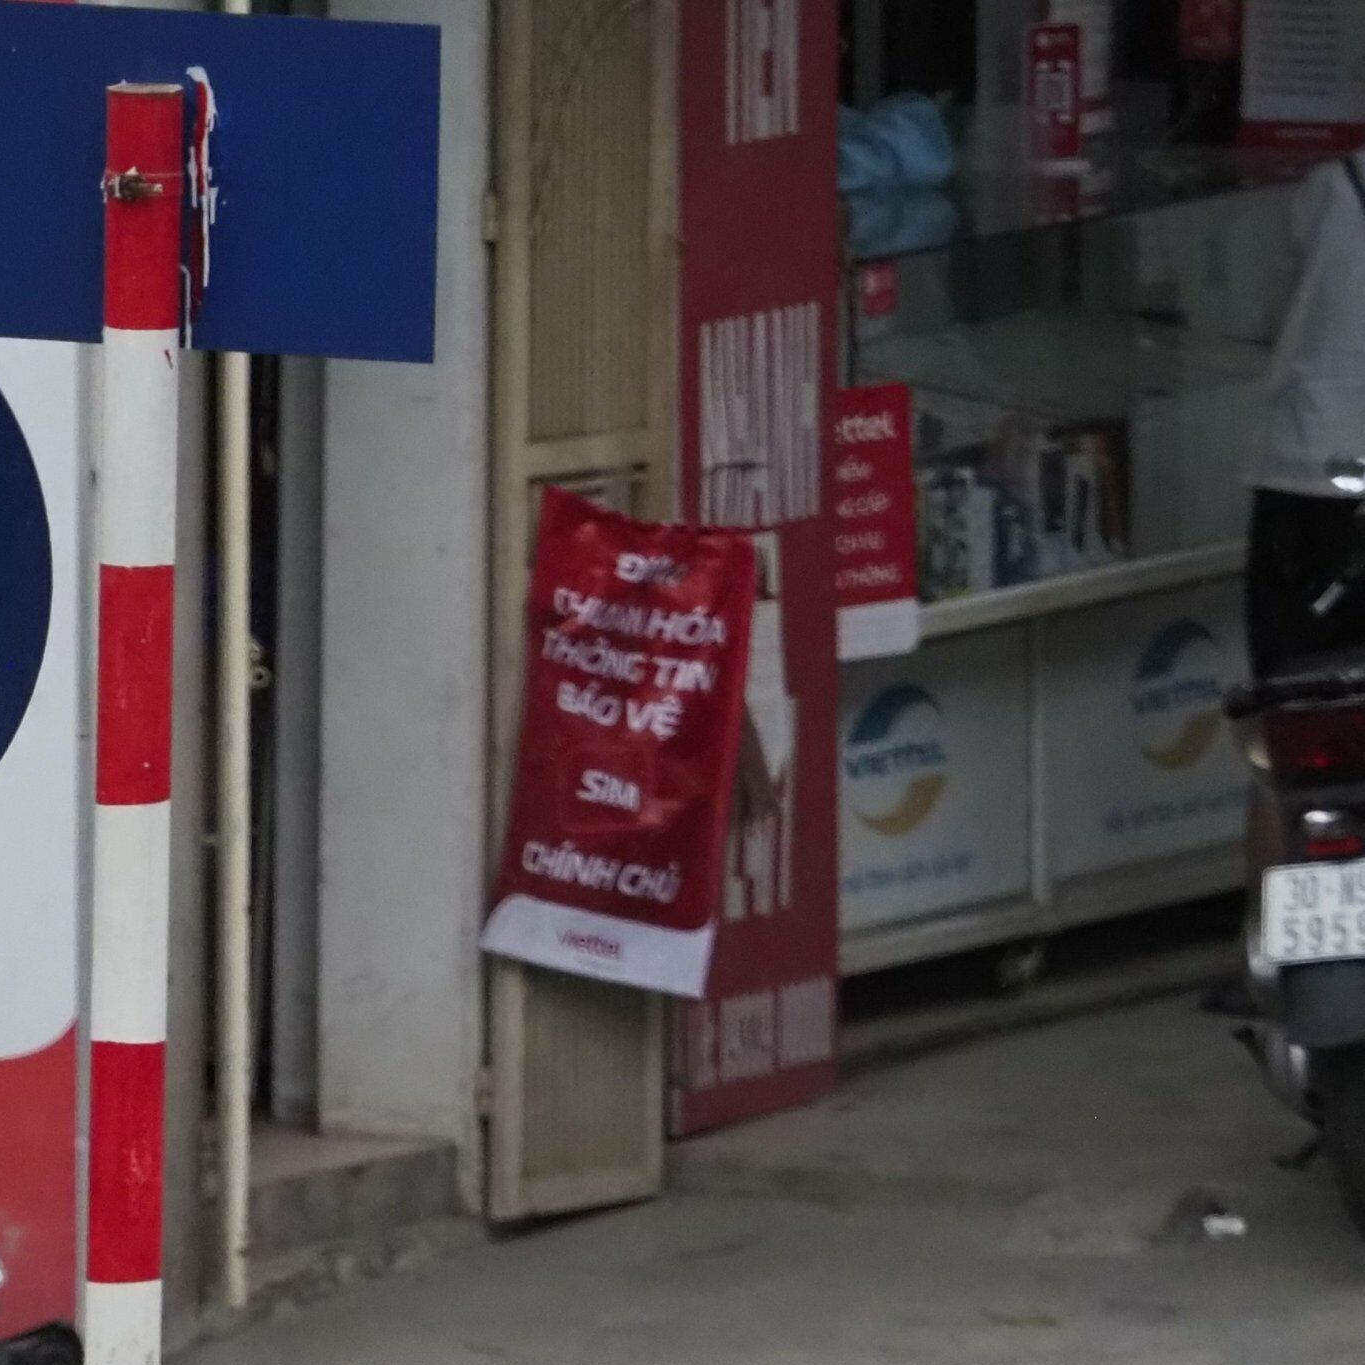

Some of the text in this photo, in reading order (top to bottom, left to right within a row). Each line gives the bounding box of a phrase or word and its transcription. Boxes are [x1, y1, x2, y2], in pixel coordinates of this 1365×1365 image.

[542, 628, 717, 694] THÔNG TIN
[626, 694, 682, 741] VỆ
[575, 767, 641, 813] SIM
[522, 839, 619, 892] CHÍNH
